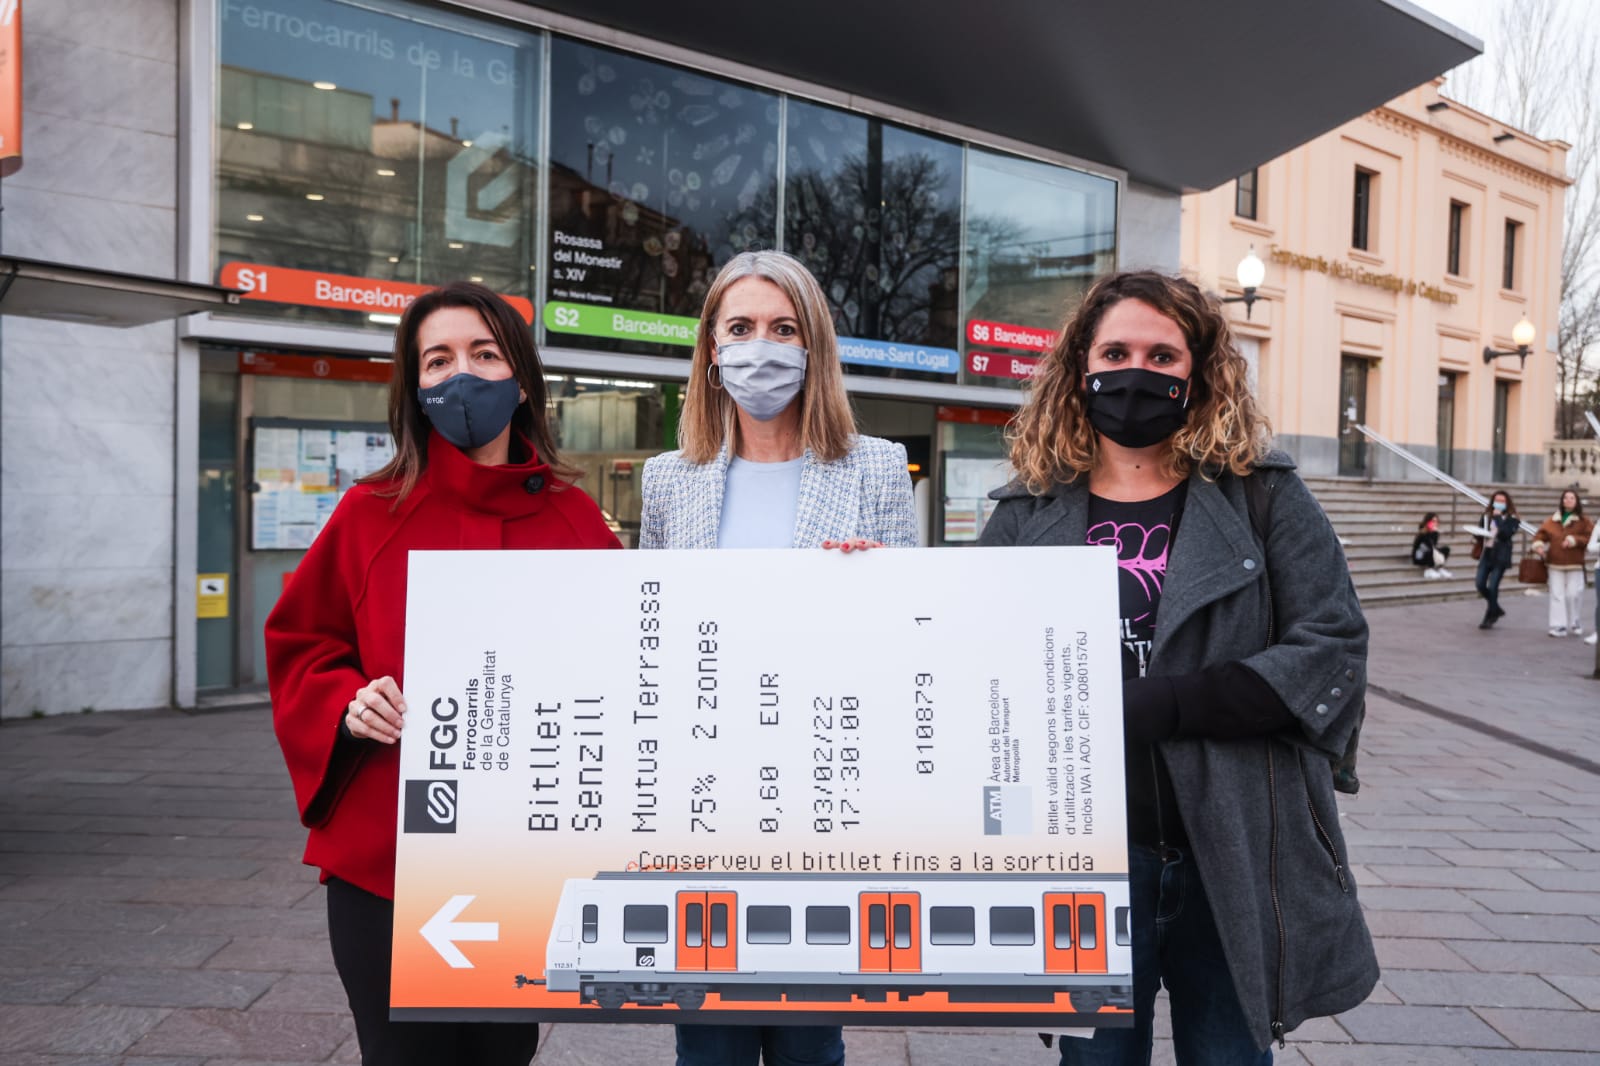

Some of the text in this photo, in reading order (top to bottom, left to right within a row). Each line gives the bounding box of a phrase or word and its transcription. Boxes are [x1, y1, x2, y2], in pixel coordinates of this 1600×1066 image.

[222, 0, 395, 60] Ferrocarrils
[407, 41, 441, 70] de
[452, 49, 475, 78] la
[553, 250, 623, 269] del Monestir
[554, 231, 603, 250] Rosassa
[237, 268, 268, 293] S1
[566, 268, 587, 282] XIV
[554, 306, 580, 327] S2
[973, 324, 990, 341] S6
[917, 350, 949, 370] Cugat
[972, 355, 990, 373] S7
[432, 396, 445, 405] FGC
[1061, 644, 1074, 690] vigents.
[1076, 632, 1089, 701] Q0801576J
[480, 651, 495, 770] de la Generalitat
[632, 582, 660, 832] Mutua Terrassa
[914, 617, 934, 774] 0110879 1
[1062, 694, 1072, 732] tarifes
[429, 697, 458, 770] FGC
[463, 679, 478, 770] Ferrocarrils
[497, 674, 514, 771] de Catalunya
[691, 622, 717, 832] 75% 2 zones
[987, 679, 1000, 782] Àrea de Barcelona
[1002, 698, 1010, 734] Transport
[1044, 627, 1059, 834] Bitllet vàlid segons les condicions
[1078, 705, 1090, 730] CIF:
[572, 696, 604, 831] Senzill
[760, 674, 782, 832] 0,60 EUR
[814, 697, 832, 832] 03/02/22
[841, 697, 859, 830] 17:30:00
[1012, 739, 1020, 782] Metropolità
[1063, 736, 1073, 753] les
[1080, 735, 1090, 763] AOV.
[528, 703, 561, 831] Bitllet
[1003, 750, 1011, 783] Autoritat
[1080, 774, 1091, 793] IVA
[990, 791, 1002, 821] ATM
[1064, 764, 1076, 835] d'utilització
[1081, 798, 1093, 834] Inclòs
[639, 851, 1093, 871] Conserveu el bitllet fins a la sortida
